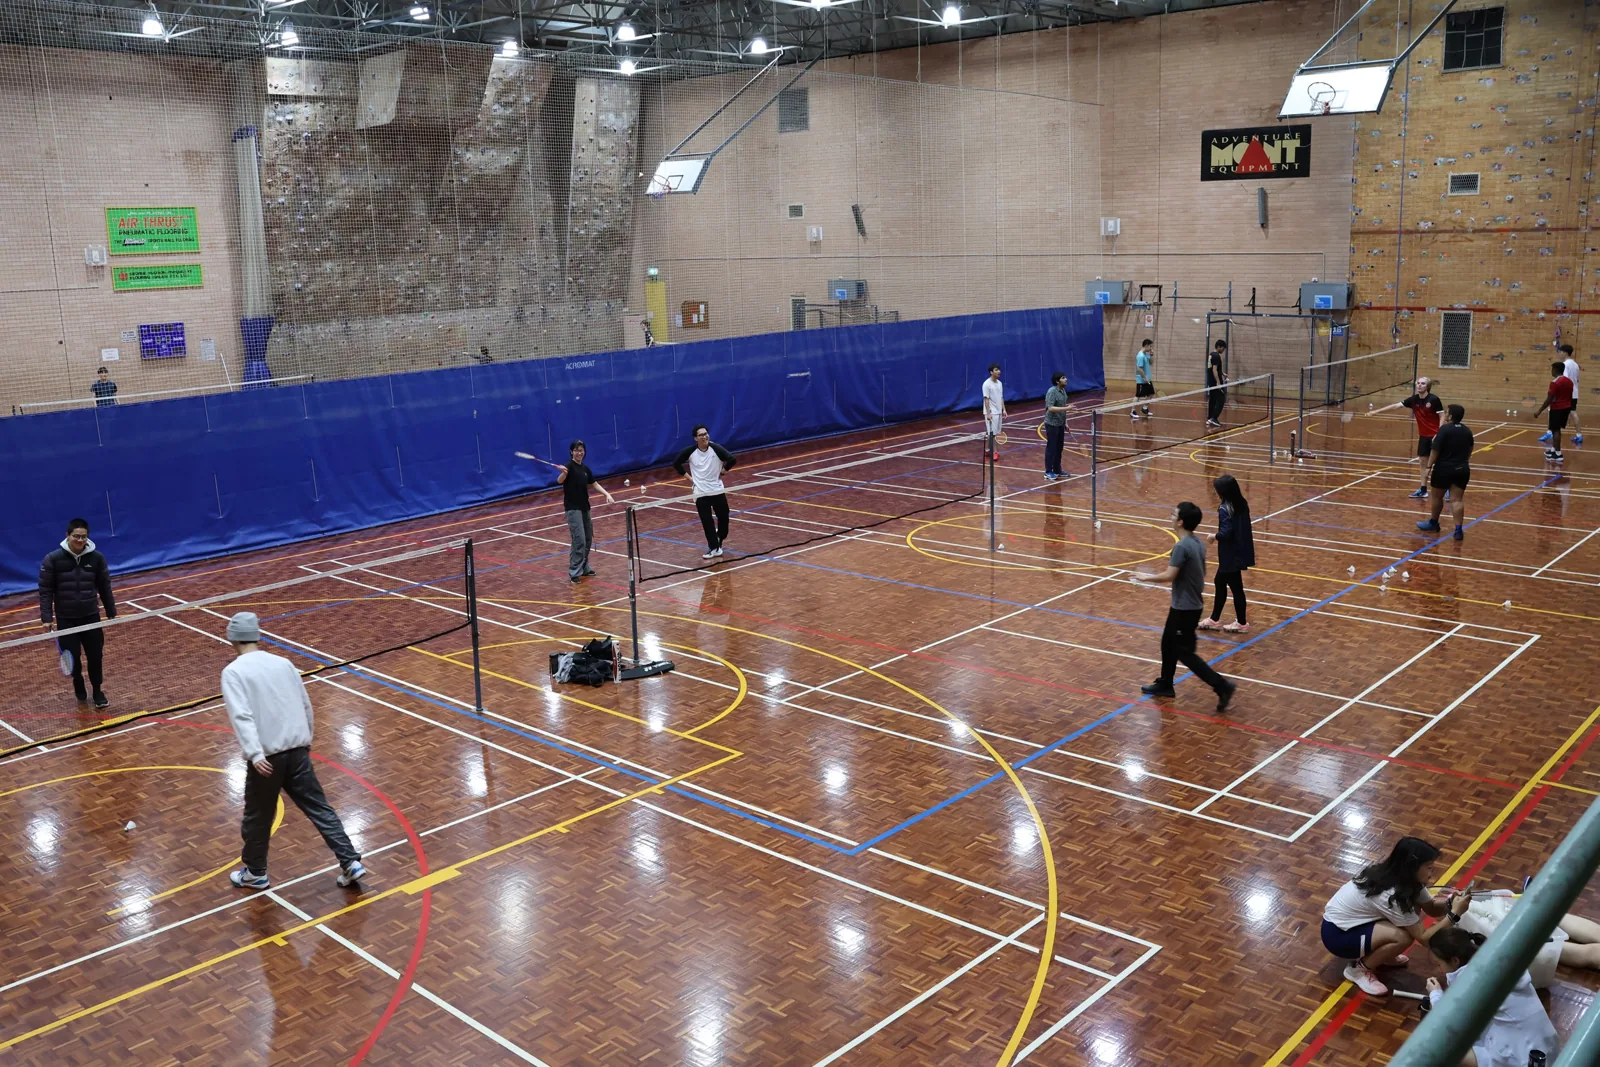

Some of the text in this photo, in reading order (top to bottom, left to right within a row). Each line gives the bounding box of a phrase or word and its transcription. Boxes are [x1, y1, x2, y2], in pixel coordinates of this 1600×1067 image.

[1211, 132, 1301, 144] ADVENTURE
[1210, 163, 1300, 174] EQUIPMENT
[565, 360, 596, 370] ACROMAT
